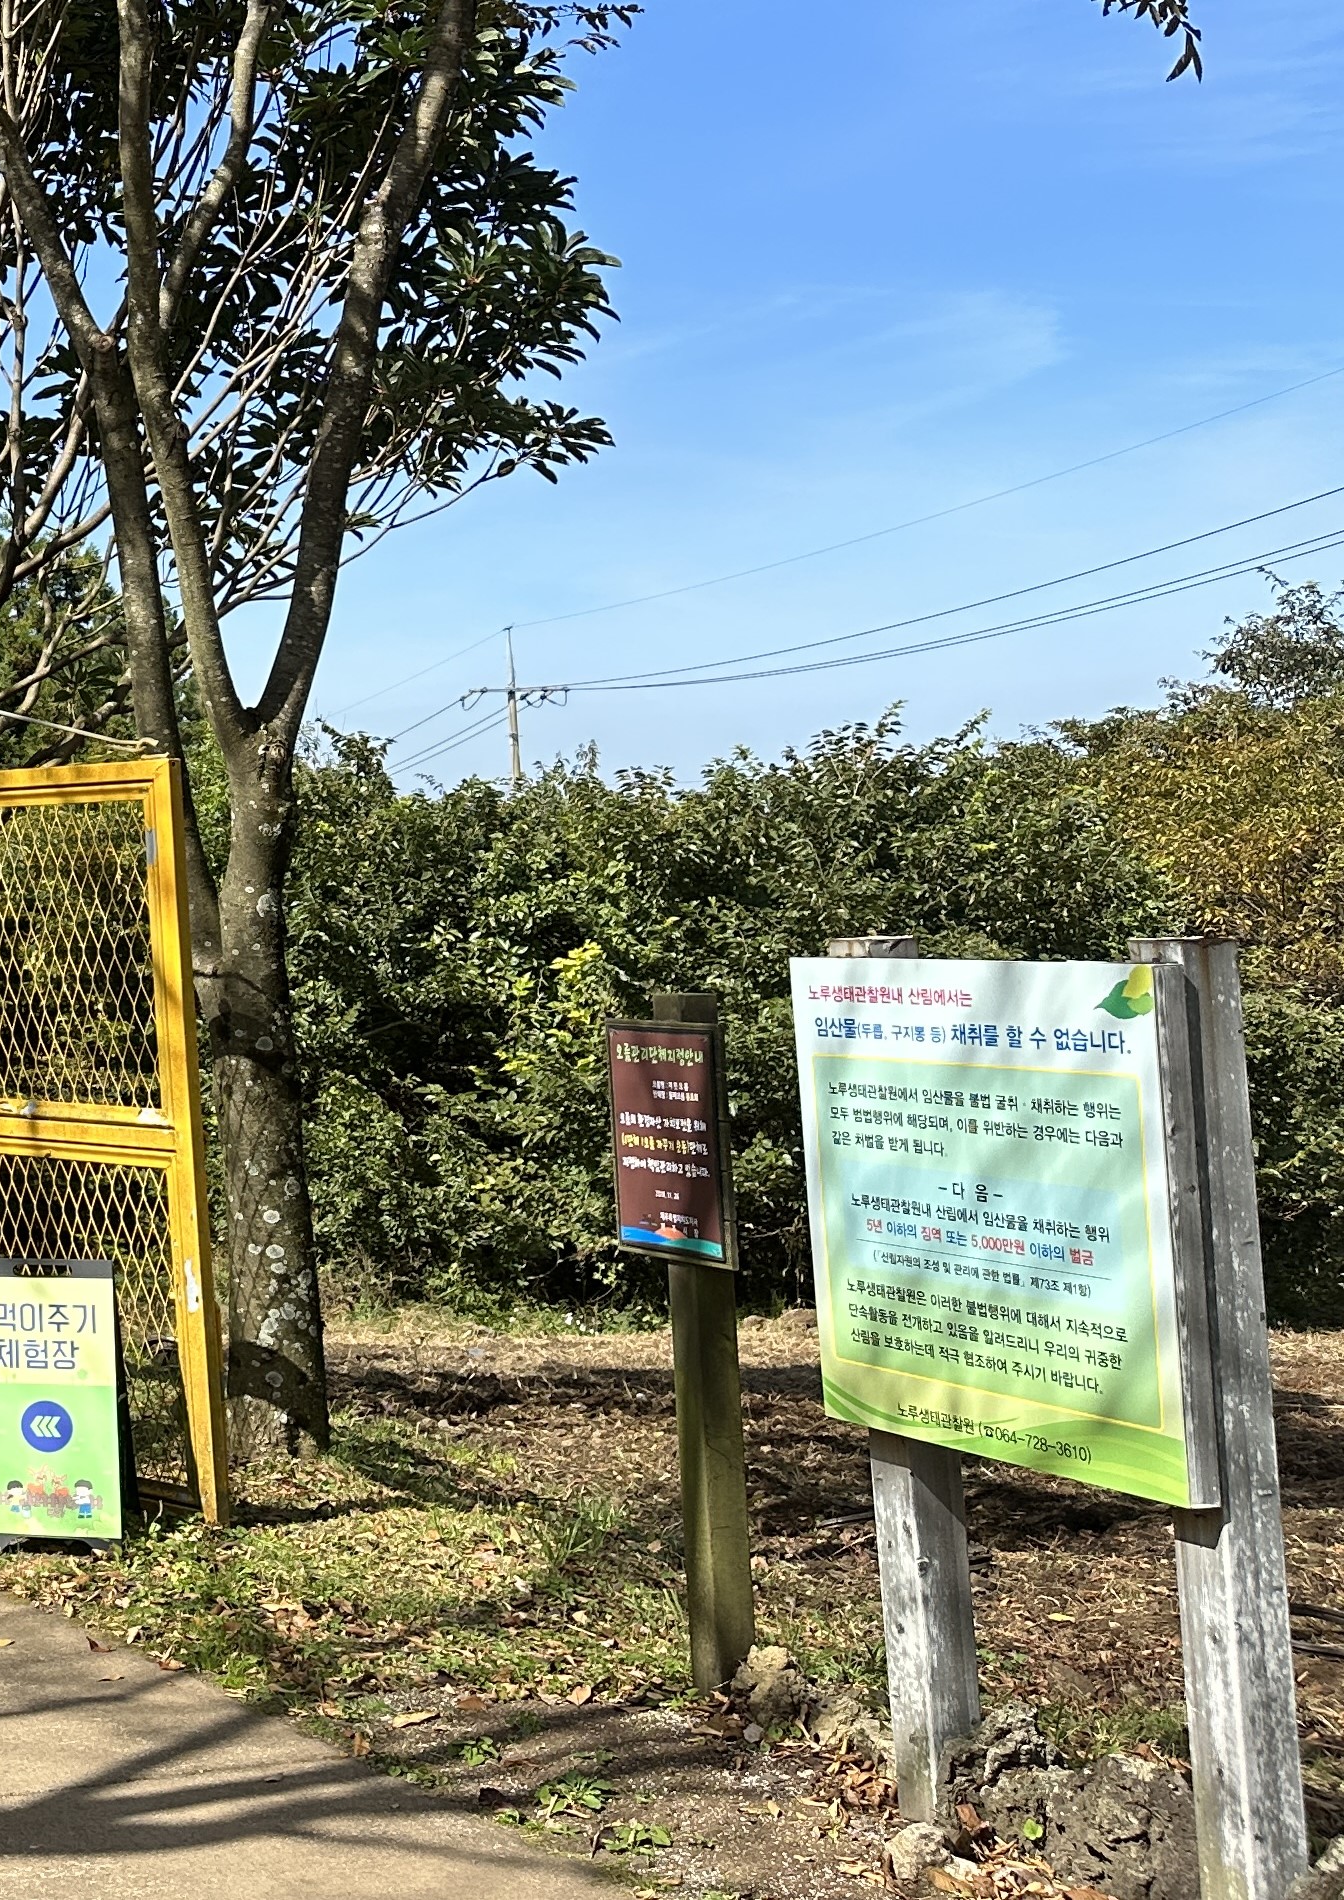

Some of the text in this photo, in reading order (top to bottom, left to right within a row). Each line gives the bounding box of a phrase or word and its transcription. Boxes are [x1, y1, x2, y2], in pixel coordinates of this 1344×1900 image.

[808, 984, 973, 1008] 노루생태관찰원내 산림에서는
[929, 1025, 947, 1044] 등)
[951, 1023, 999, 1047] 채취를
[1005, 1025, 1023, 1049] 할
[1028, 1026, 1047, 1050] 수
[1053, 1027, 1132, 1055] 없습니다.
[827, 1081, 918, 1103] 노루생태관찰원에서
[922, 1088, 965, 1107] 임산물을
[968, 1092, 991, 1109] 불법
[995, 1094, 1018, 1112] 굴취
[1030, 1097, 1079, 1117] 채취하는
[1083, 1101, 1122, 1120] 행위는
[830, 1106, 849, 1121] 모두
[906, 1113, 953, 1132] 해당되며,
[956, 1117, 979, 1134] 이를
[982, 1120, 1029, 1140] 위반하는
[1032, 1124, 1081, 1144] 경우에는
[1085, 1129, 1124, 1148] 다음과
[831, 1130, 948, 1157] 같은 처벌을 받게 됩니다.
[850, 1192, 1110, 1243] 노루생태관찰원내 산림에서 임산물을 채취하는 행위
[866, 1218, 883, 1234] 5년
[886, 1220, 917, 1239] 이하의
[920, 1226, 942, 1243] 징역
[946, 1230, 968, 1247] 또는
[1029, 1242, 1065, 1262] 이하의
[1069, 1247, 1094, 1266] 벌금
[923, 1258, 940, 1273] 조성
[942, 1261, 951, 1275] 및
[953, 1263, 980, 1280] 관리에
[982, 1268, 1000, 1283] 관한
[1030, 1276, 1060, 1292] 제73조
[1063, 1281, 1092, 1299] 제1항)
[847, 1278, 1129, 1344] 노루생태관찰원은 이러한 불법행위에 대해서 지속적으로
[848, 1302, 898, 1327] 단속활동을
[901, 1313, 943, 1334] 전개하고
[983, 1328, 1040, 1355] 알려드리니
[1044, 1340, 1081, 1363] 우리의
[1084, 1349, 1123, 1371] 귀중한
[851, 1327, 1104, 1395] 산림을 보호하는데 적극 협조하여 주시기 바랍니다.
[896, 1402, 975, 1435] 노루생태관찰원
